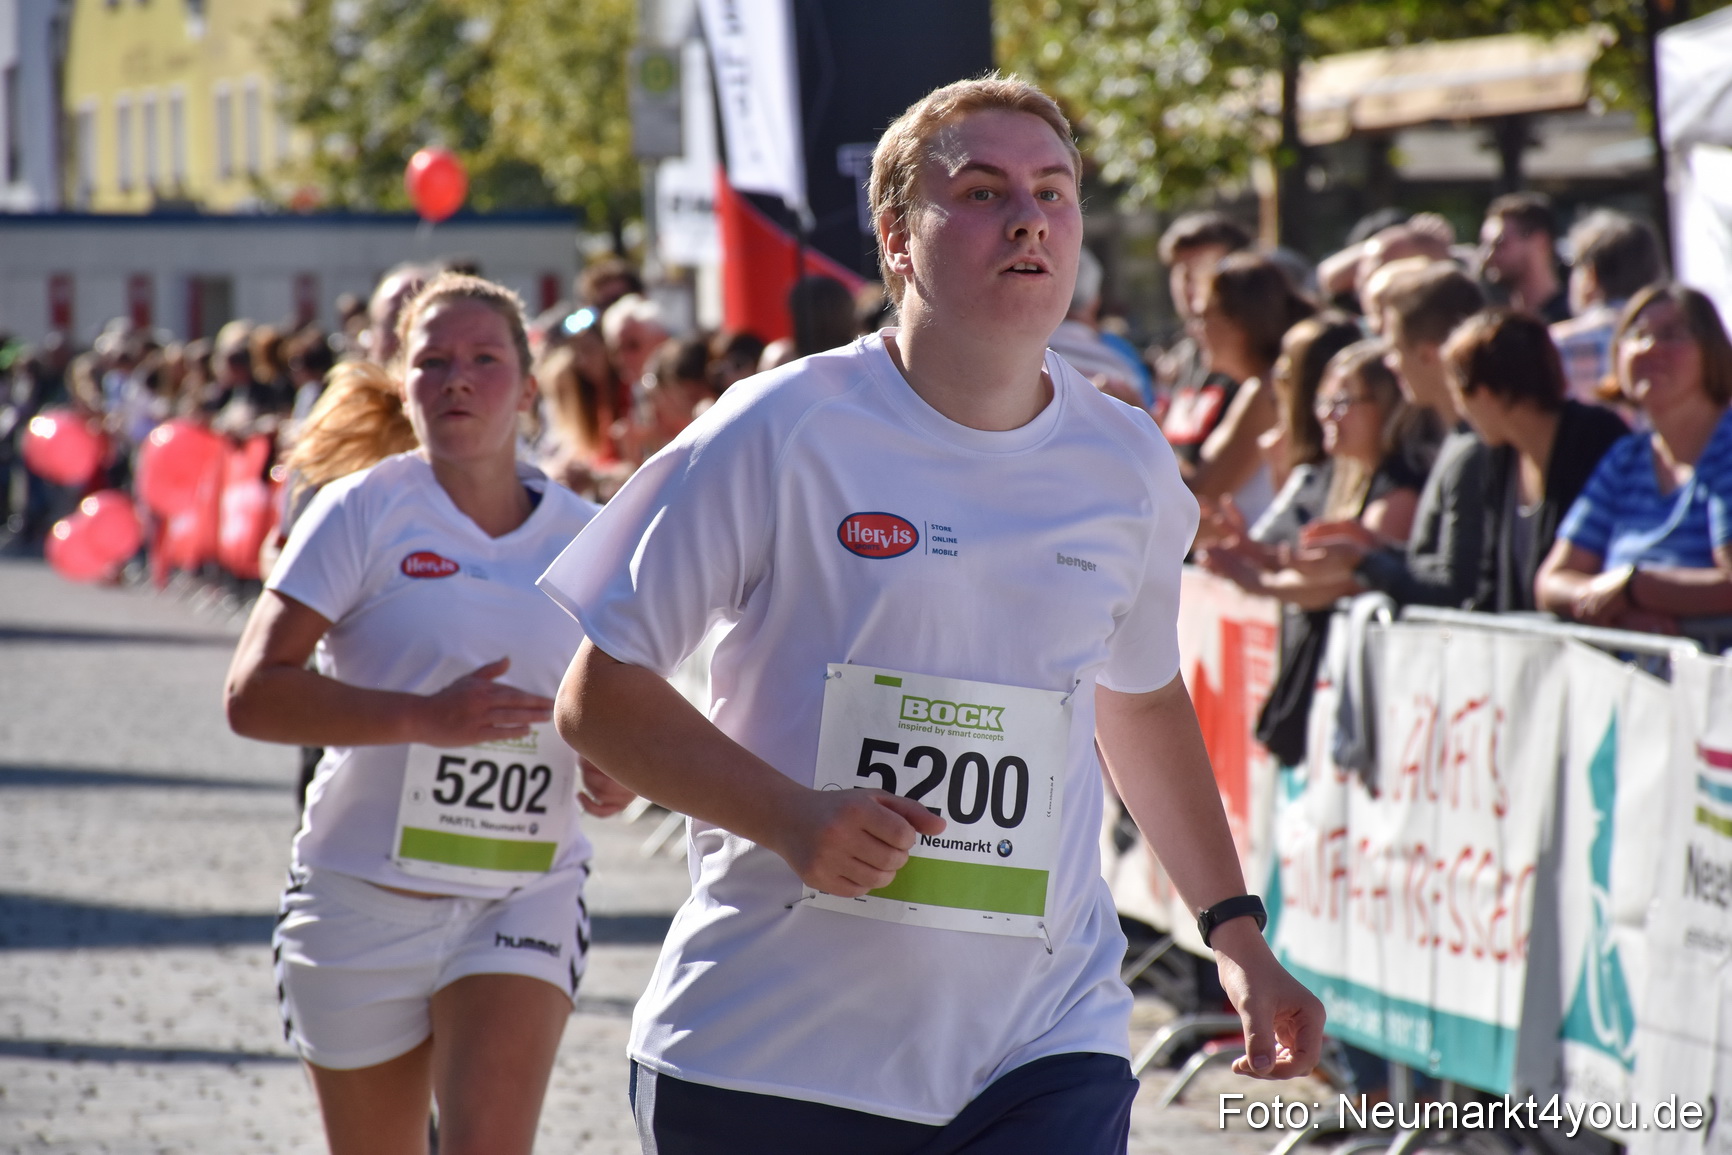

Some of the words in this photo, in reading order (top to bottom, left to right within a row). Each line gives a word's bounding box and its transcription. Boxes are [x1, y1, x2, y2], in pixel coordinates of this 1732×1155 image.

[846, 521, 912, 548] Hervis
[931, 524, 952, 532] STORE
[854, 543, 881, 551] SPORTS
[932, 536, 958, 544] ONLINE
[932, 548, 959, 557] MOBILE
[1056, 552, 1097, 572] benger
[901, 696, 1004, 731] BOCK
[898, 720, 933, 733] inspired
[934, 726, 946, 736] by
[947, 728, 971, 738] smart
[972, 732, 1004, 742] concepts
[432, 755, 552, 815] 5202
[854, 737, 1030, 829] 5200
[920, 834, 992, 854] Neumarkt
